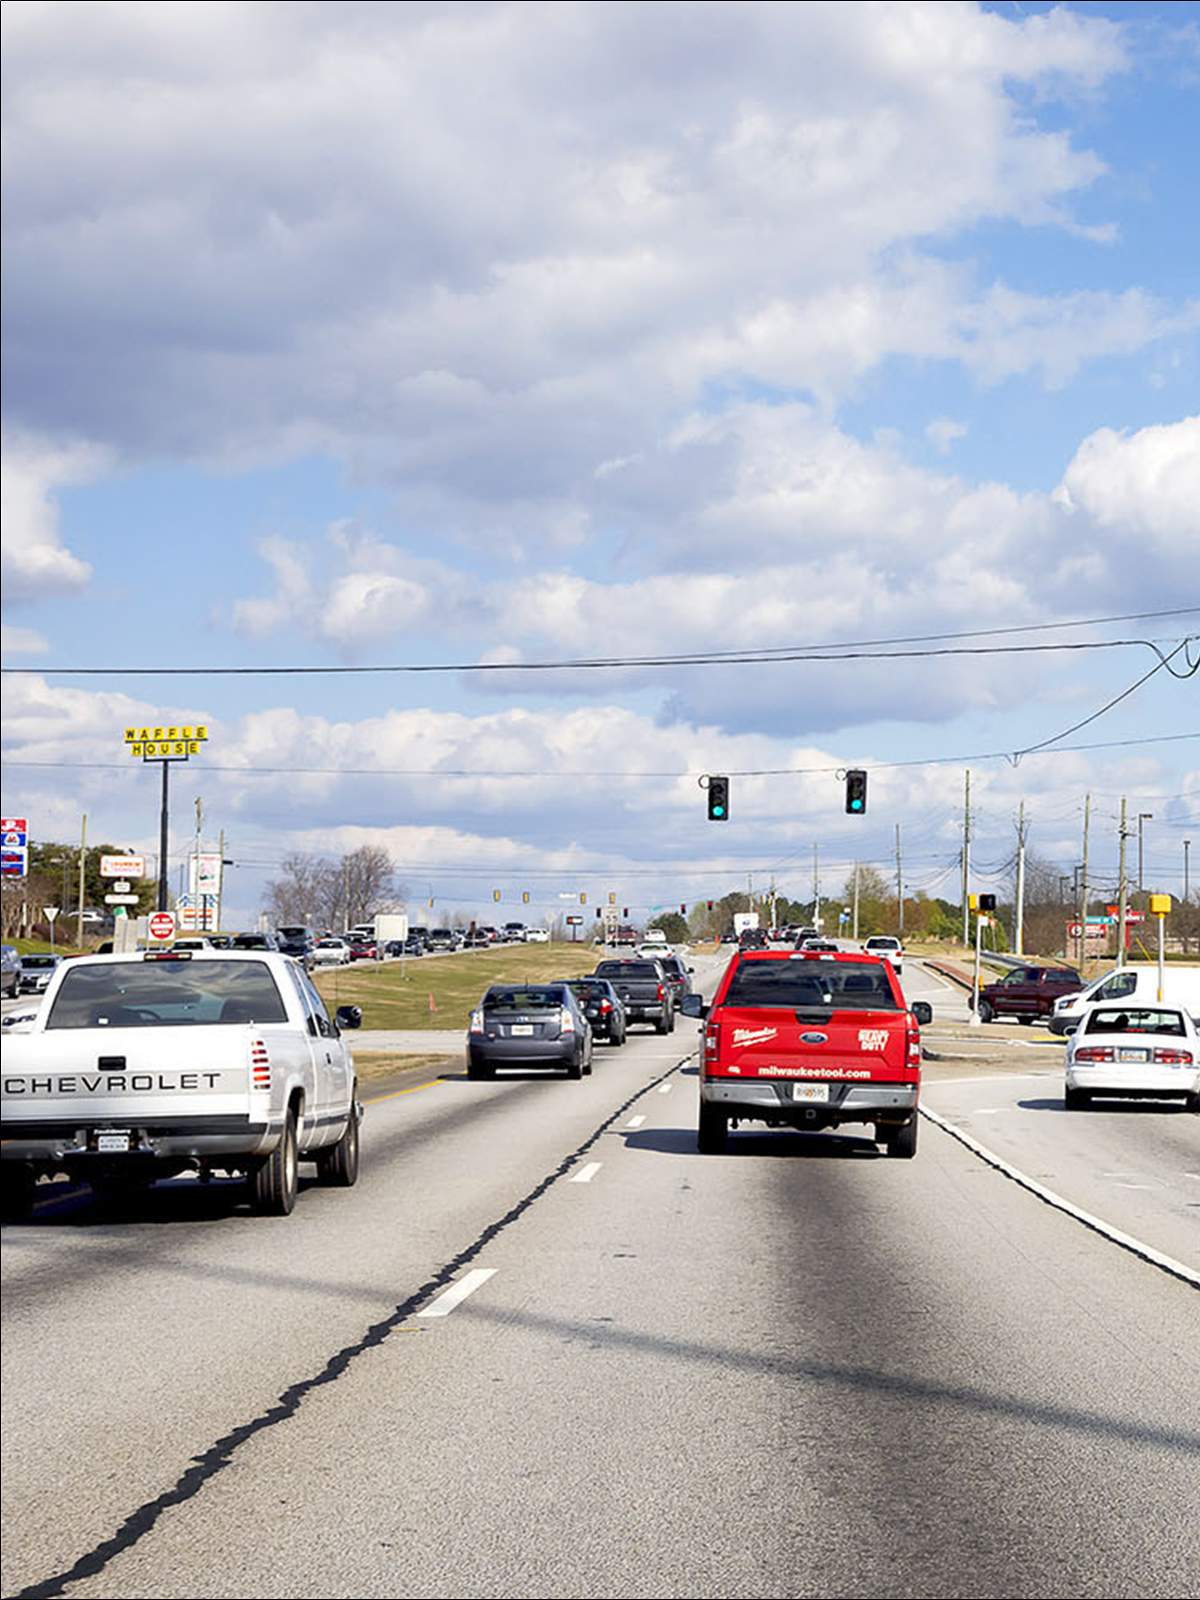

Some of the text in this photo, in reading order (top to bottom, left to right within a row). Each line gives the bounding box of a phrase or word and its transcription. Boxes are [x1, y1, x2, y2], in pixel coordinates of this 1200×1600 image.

[126, 726, 206, 740] WAFFLE
[132, 742, 198, 755] HOUSE
[861, 1040, 887, 1051] DUTY
[758, 1066, 871, 1079] milwaukeetool.com
[4, 1073, 222, 1095] CHEVROLET
